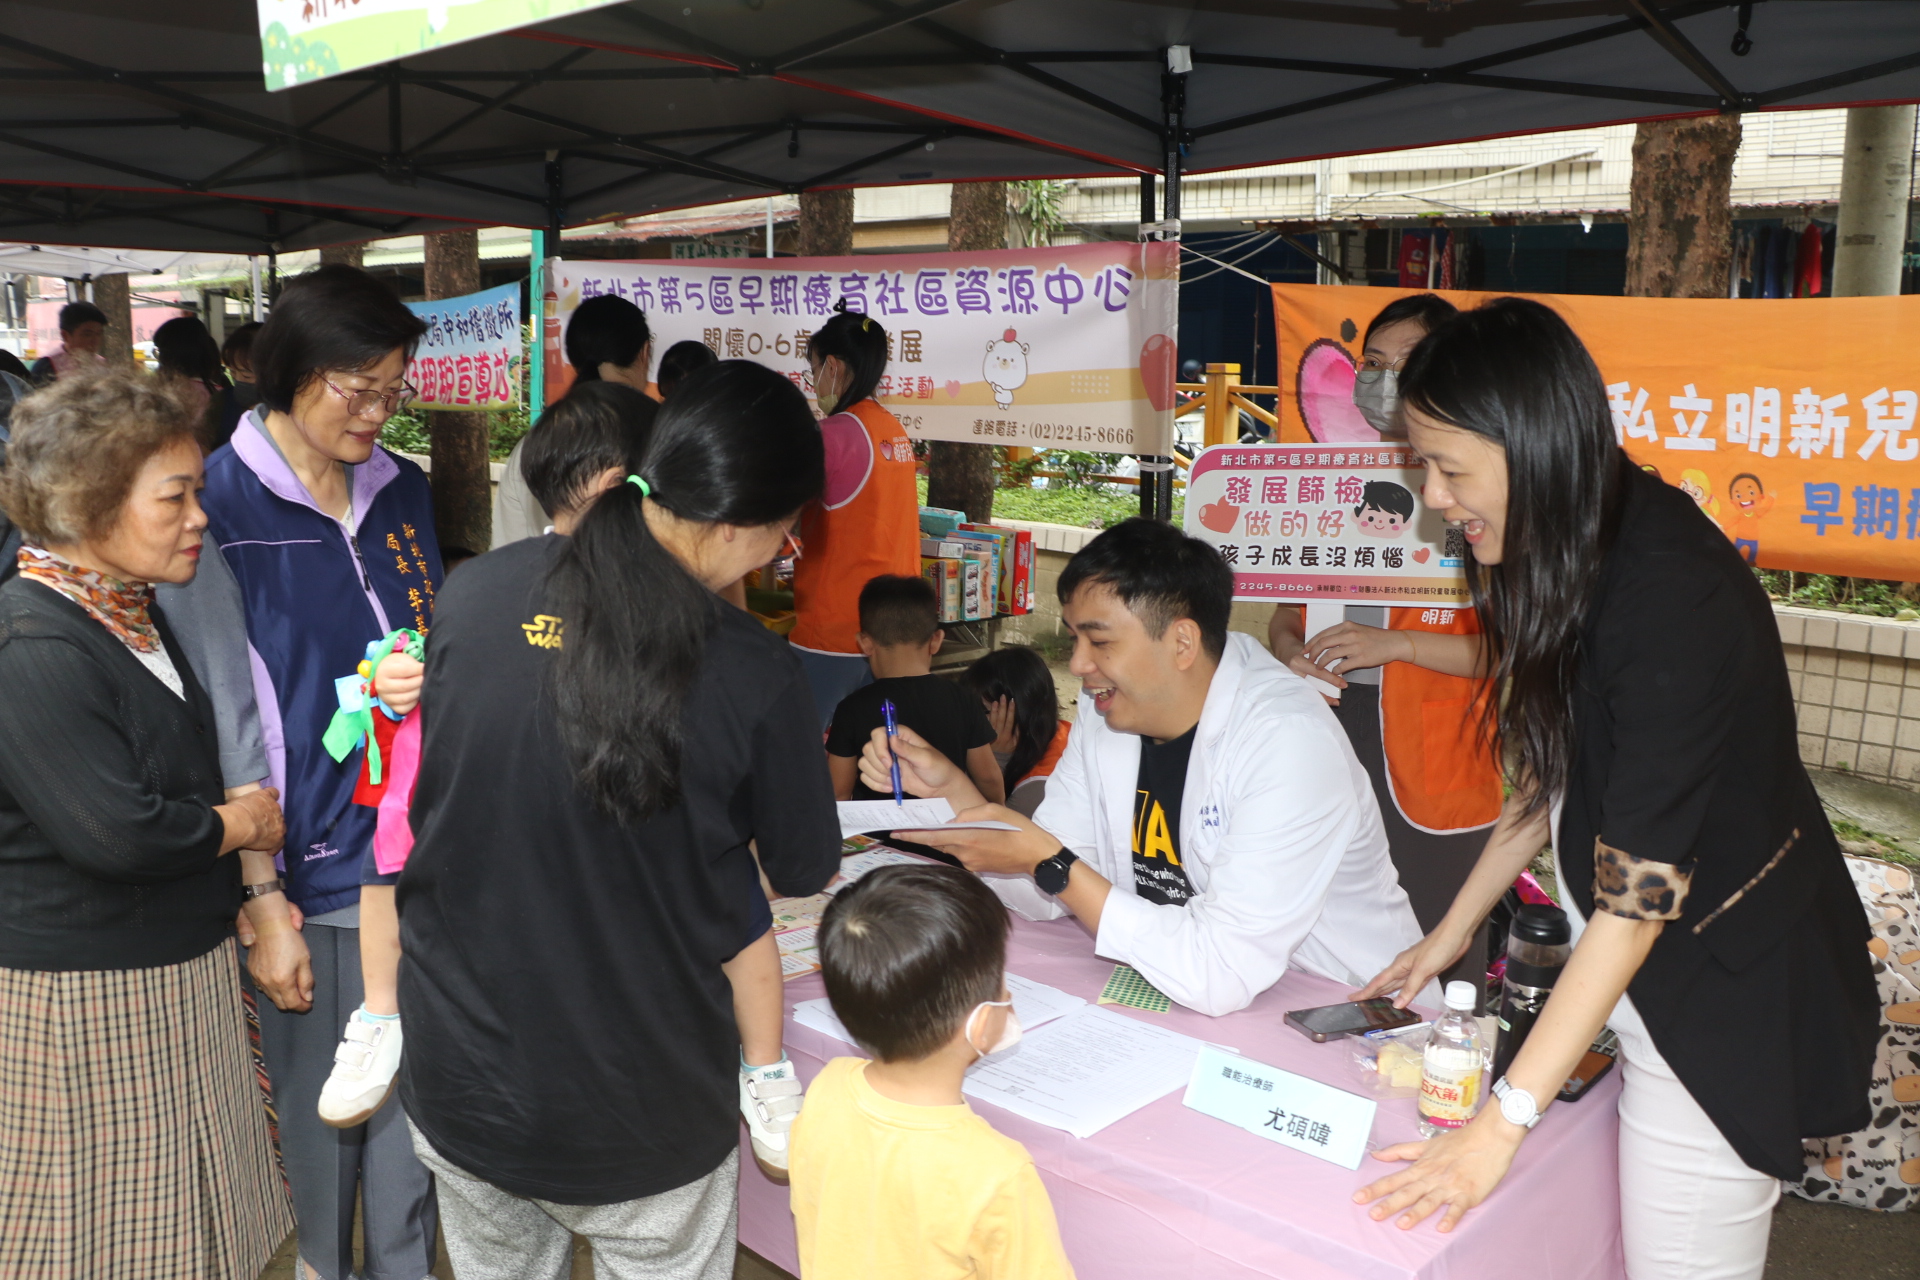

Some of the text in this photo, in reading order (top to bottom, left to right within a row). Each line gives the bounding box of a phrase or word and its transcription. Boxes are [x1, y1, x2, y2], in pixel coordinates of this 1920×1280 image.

[1225, 475, 1363, 505] 發展篩檢
[1244, 509, 1345, 539] 做的好
[386, 532, 413, 575] 局長
[1219, 544, 1404, 569] 孩子成長沒煩惱
[1421, 608, 1455, 625] 明新
[1221, 1066, 1274, 1093] 職能治療師
[1263, 1107, 1332, 1147] 尤碩暐
[1862, 1158, 1897, 1171] WOW
